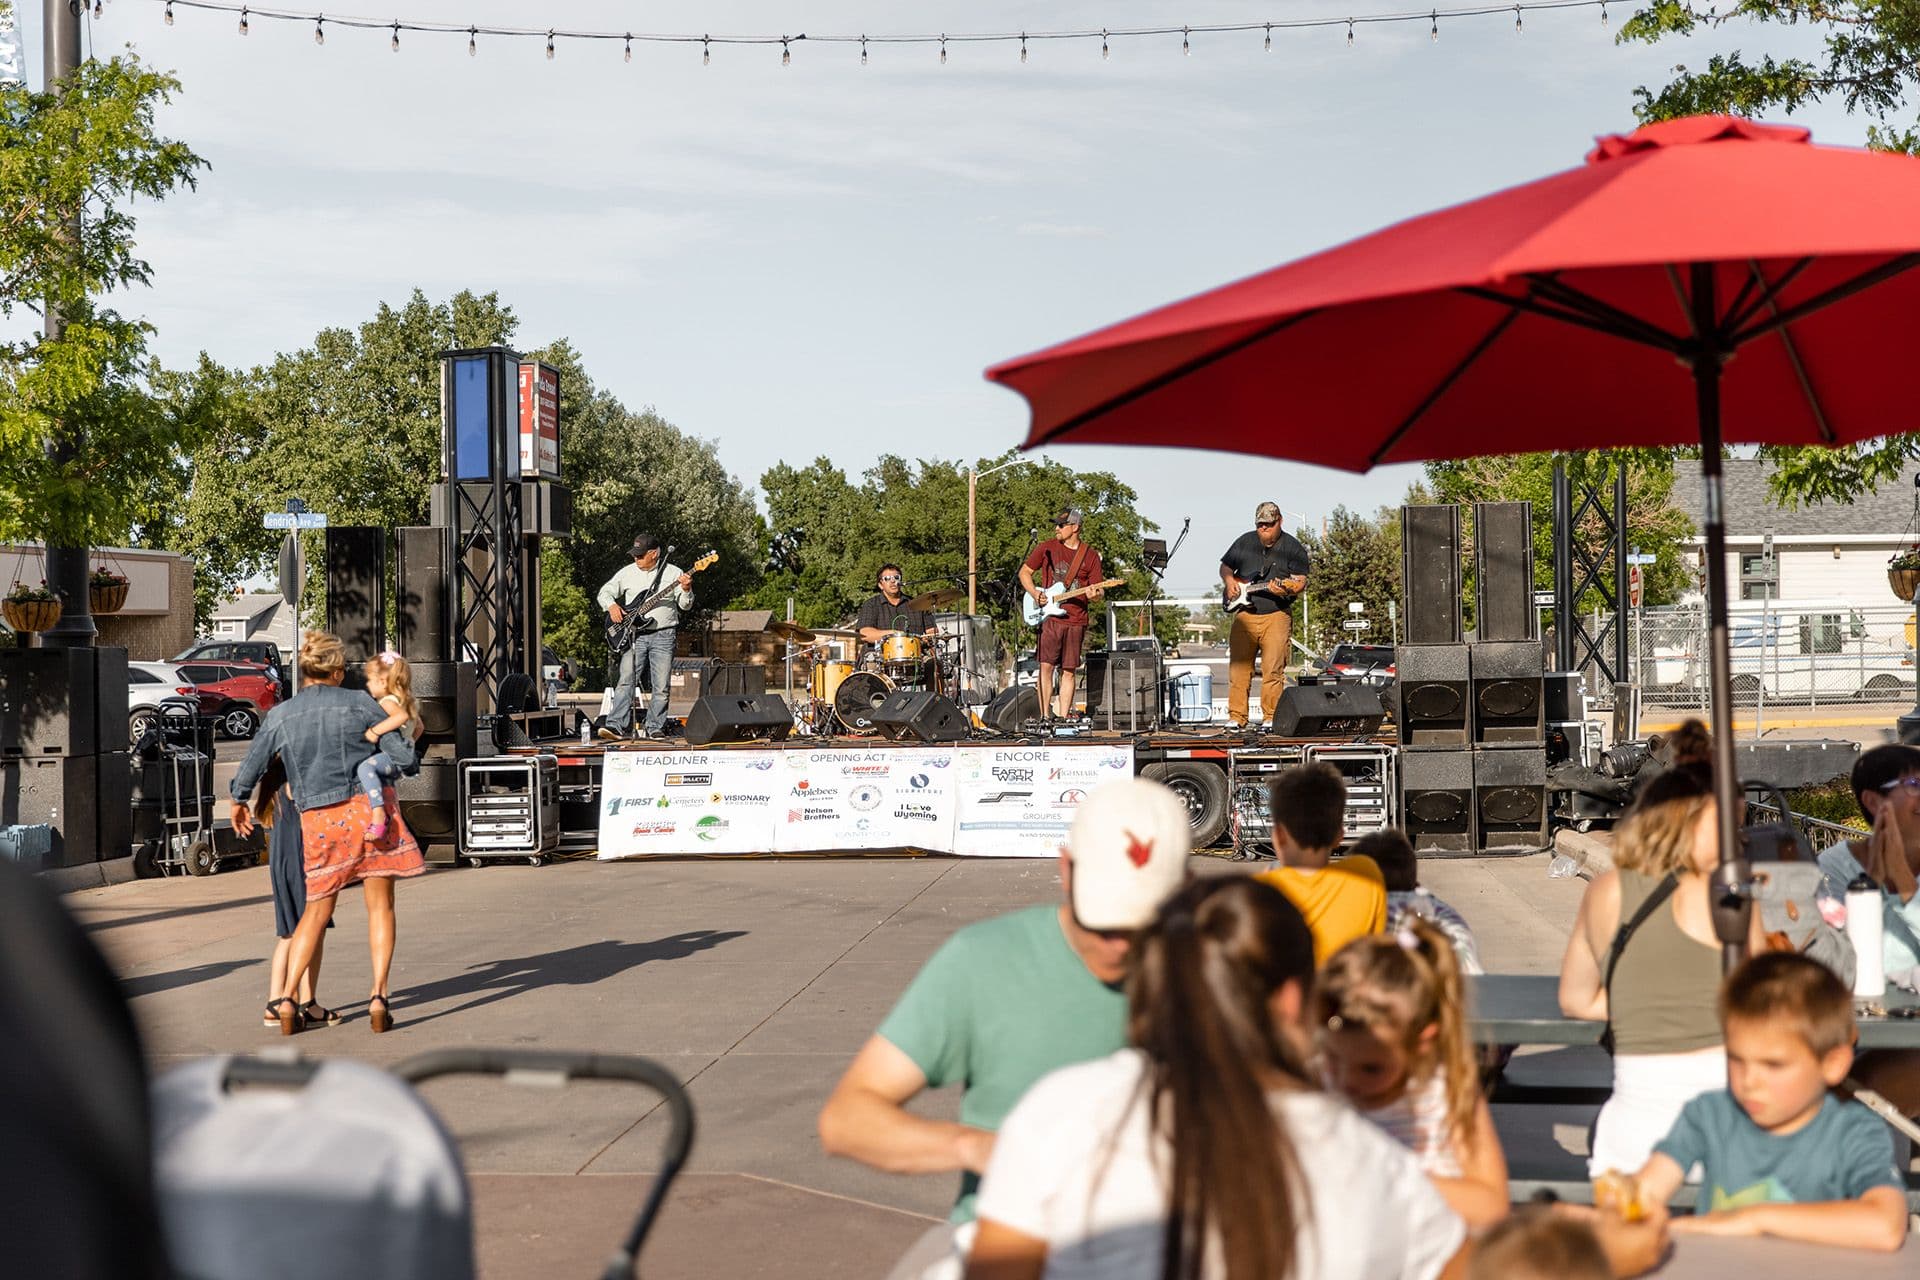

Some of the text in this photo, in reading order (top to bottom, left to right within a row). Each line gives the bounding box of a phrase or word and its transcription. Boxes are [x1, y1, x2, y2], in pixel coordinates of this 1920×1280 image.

[264, 514, 312, 527] Kendrick Ave
[636, 756, 708, 765] HEADLINER
[810, 754, 861, 762] OPENING
[996, 752, 1050, 761] ENCORE
[992, 767, 1034, 776] EARTH
[997, 774, 1033, 782] WORK
[624, 797, 655, 807] FIRST
[724, 794, 770, 802] VISIONARY
[906, 803, 932, 811] Lve
[804, 813, 840, 821] Brothers
[894, 810, 937, 822] Wyoming
[1022, 812, 1062, 820] GROUPIES
